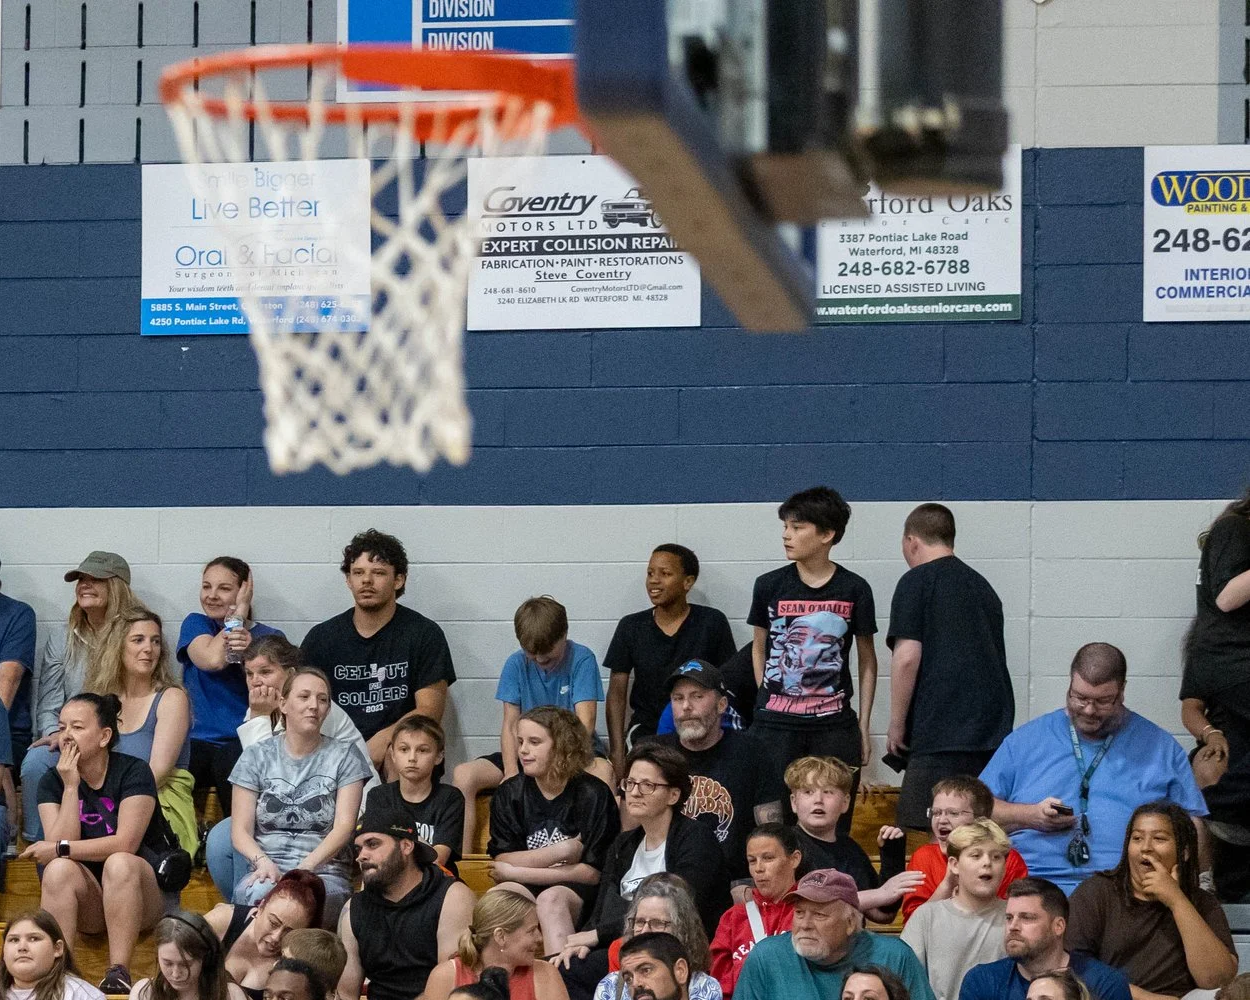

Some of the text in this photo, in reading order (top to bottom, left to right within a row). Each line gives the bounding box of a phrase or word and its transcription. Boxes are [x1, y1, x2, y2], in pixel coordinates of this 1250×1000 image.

[429, 0, 495, 18] DIVISION
[428, 32, 494, 51] DIVISION
[255, 171, 317, 191] Bigger
[482, 186, 598, 216] Coventry
[948, 192, 1013, 212] Oaks
[192, 197, 320, 220] Live Better
[1187, 203, 1247, 213] PAINTING &
[481, 220, 598, 232] MOTORS LTD
[839, 232, 968, 243] 3387 Pontiac Lake Road
[481, 239, 538, 252] EXPERT
[543, 238, 627, 251] COLLISION
[849, 246, 959, 256] Waterford, MI 48328
[175, 244, 228, 266] Oral
[264, 243, 338, 264] Facial
[838, 260, 970, 276] 248-682-6788
[535, 269, 632, 280] Steve Coventry
[168, 285, 186, 293] Your
[187, 285, 215, 293] wisdom
[822, 282, 986, 294] LICENSED ASSISTED LIVING
[517, 296, 557, 304] ELIZABETH
[151, 303, 172, 312] 5885
[175, 303, 183, 311] S.
[185, 302, 207, 311] Main
[209, 302, 239, 312] Street,
[150, 318, 172, 326] 4250
[174, 317, 207, 326] Pontiac
[209, 317, 230, 325] Lake
[232, 316, 246, 326] Rd,
[780, 604, 805, 613] SEAN
[339, 685, 408, 705] SOLDIERS
[366, 704, 384, 713] 2023
